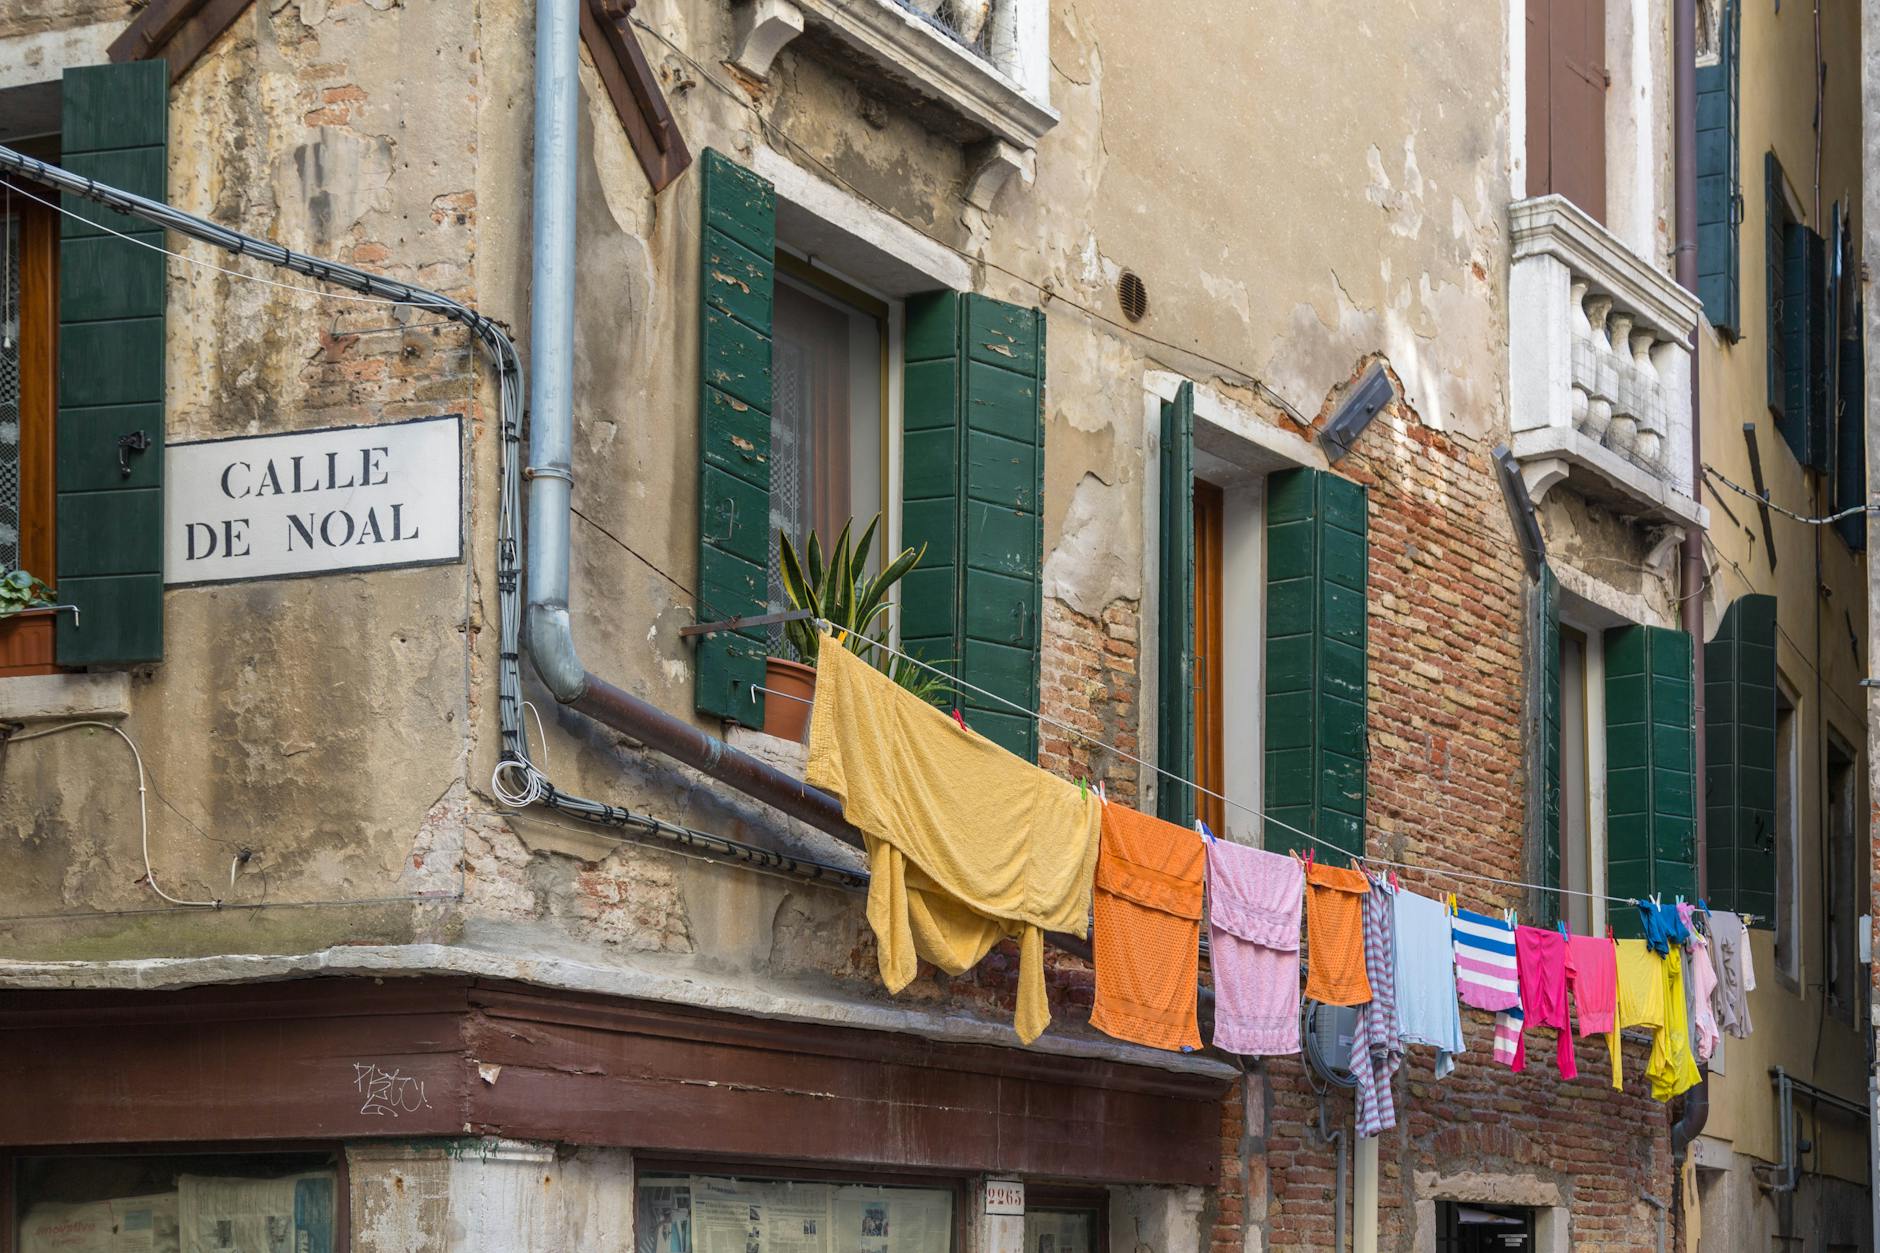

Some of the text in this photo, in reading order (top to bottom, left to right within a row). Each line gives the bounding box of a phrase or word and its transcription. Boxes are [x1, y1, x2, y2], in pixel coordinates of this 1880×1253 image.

[220, 446, 389, 499] CALLE
[185, 503, 419, 561] DE NOAL
[988, 1187, 1022, 1206] 2265
